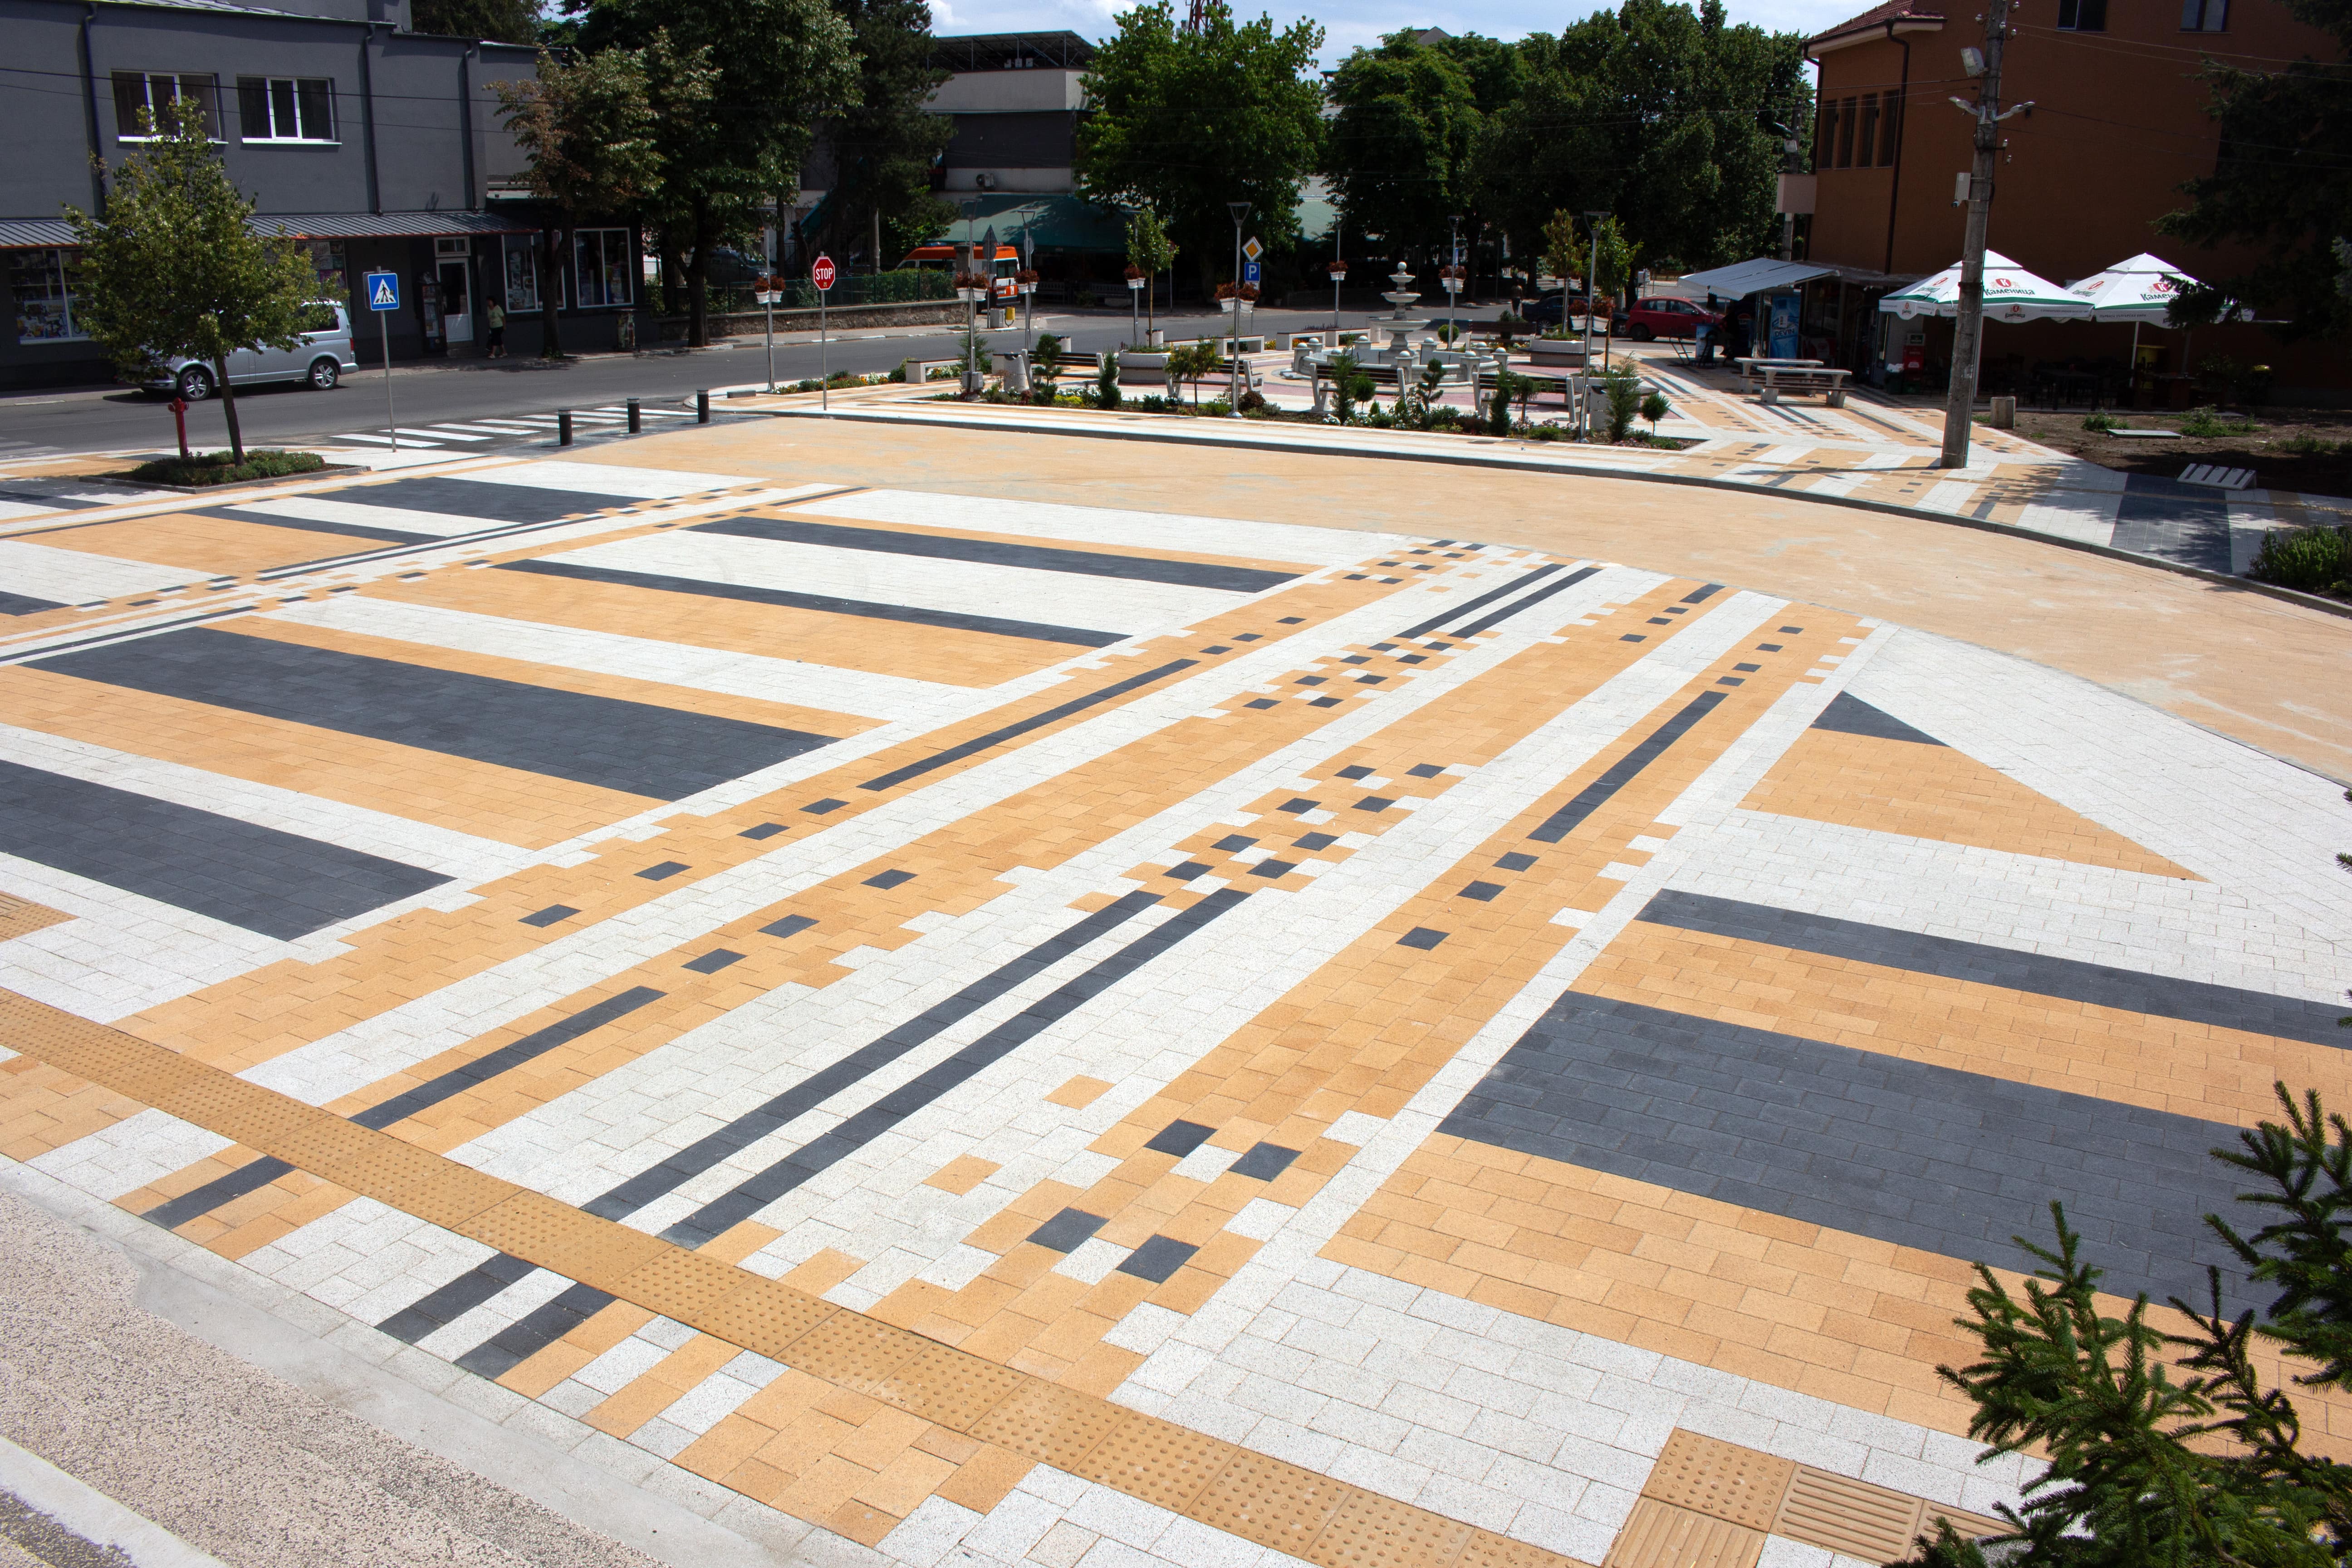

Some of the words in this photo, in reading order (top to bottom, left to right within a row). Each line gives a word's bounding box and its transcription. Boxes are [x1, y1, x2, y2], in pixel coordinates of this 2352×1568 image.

[816, 268, 833, 280] STOP
[1249, 265, 1257, 279] P
[2140, 293, 2180, 301] Камени
[1774, 328, 1795, 337] DEVIN
